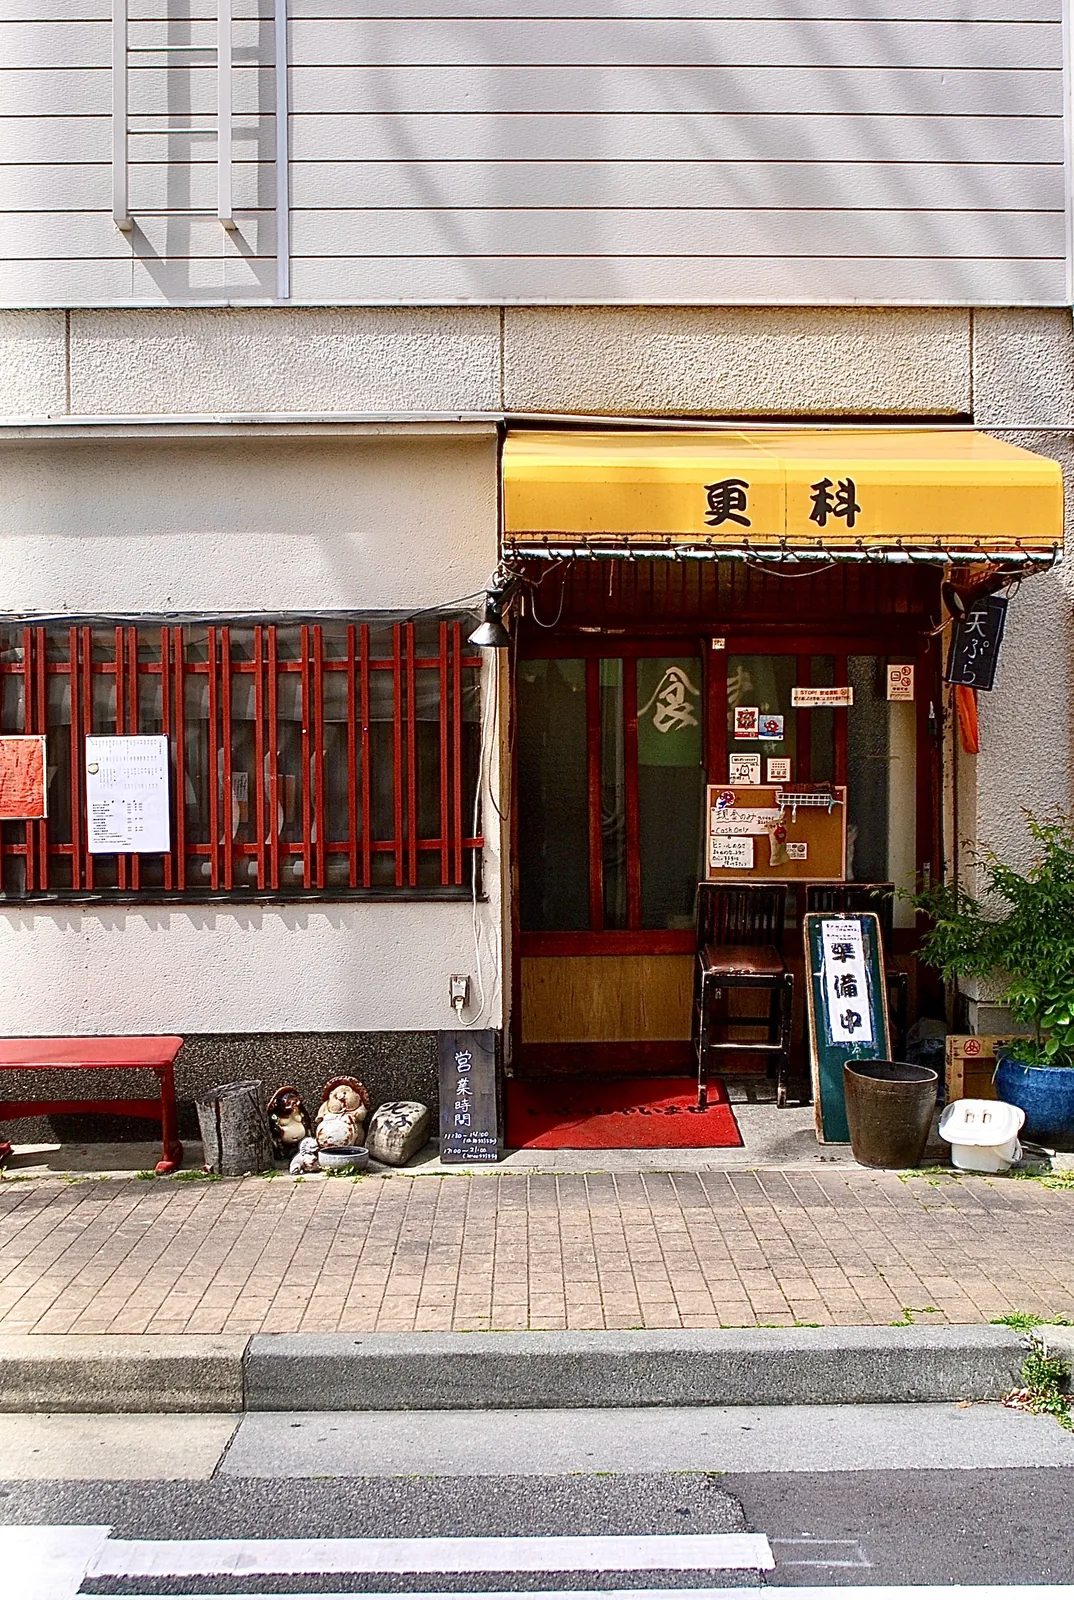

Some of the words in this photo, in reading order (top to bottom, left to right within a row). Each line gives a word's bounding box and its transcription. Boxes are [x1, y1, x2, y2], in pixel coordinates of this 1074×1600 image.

[703, 477, 861, 528] 更科
[962, 611, 990, 684] 天ぷら
[716, 808, 757, 821] 現金のみ
[830, 942, 862, 1034] 準備中
[454, 1049, 473, 1127] 営業時間
